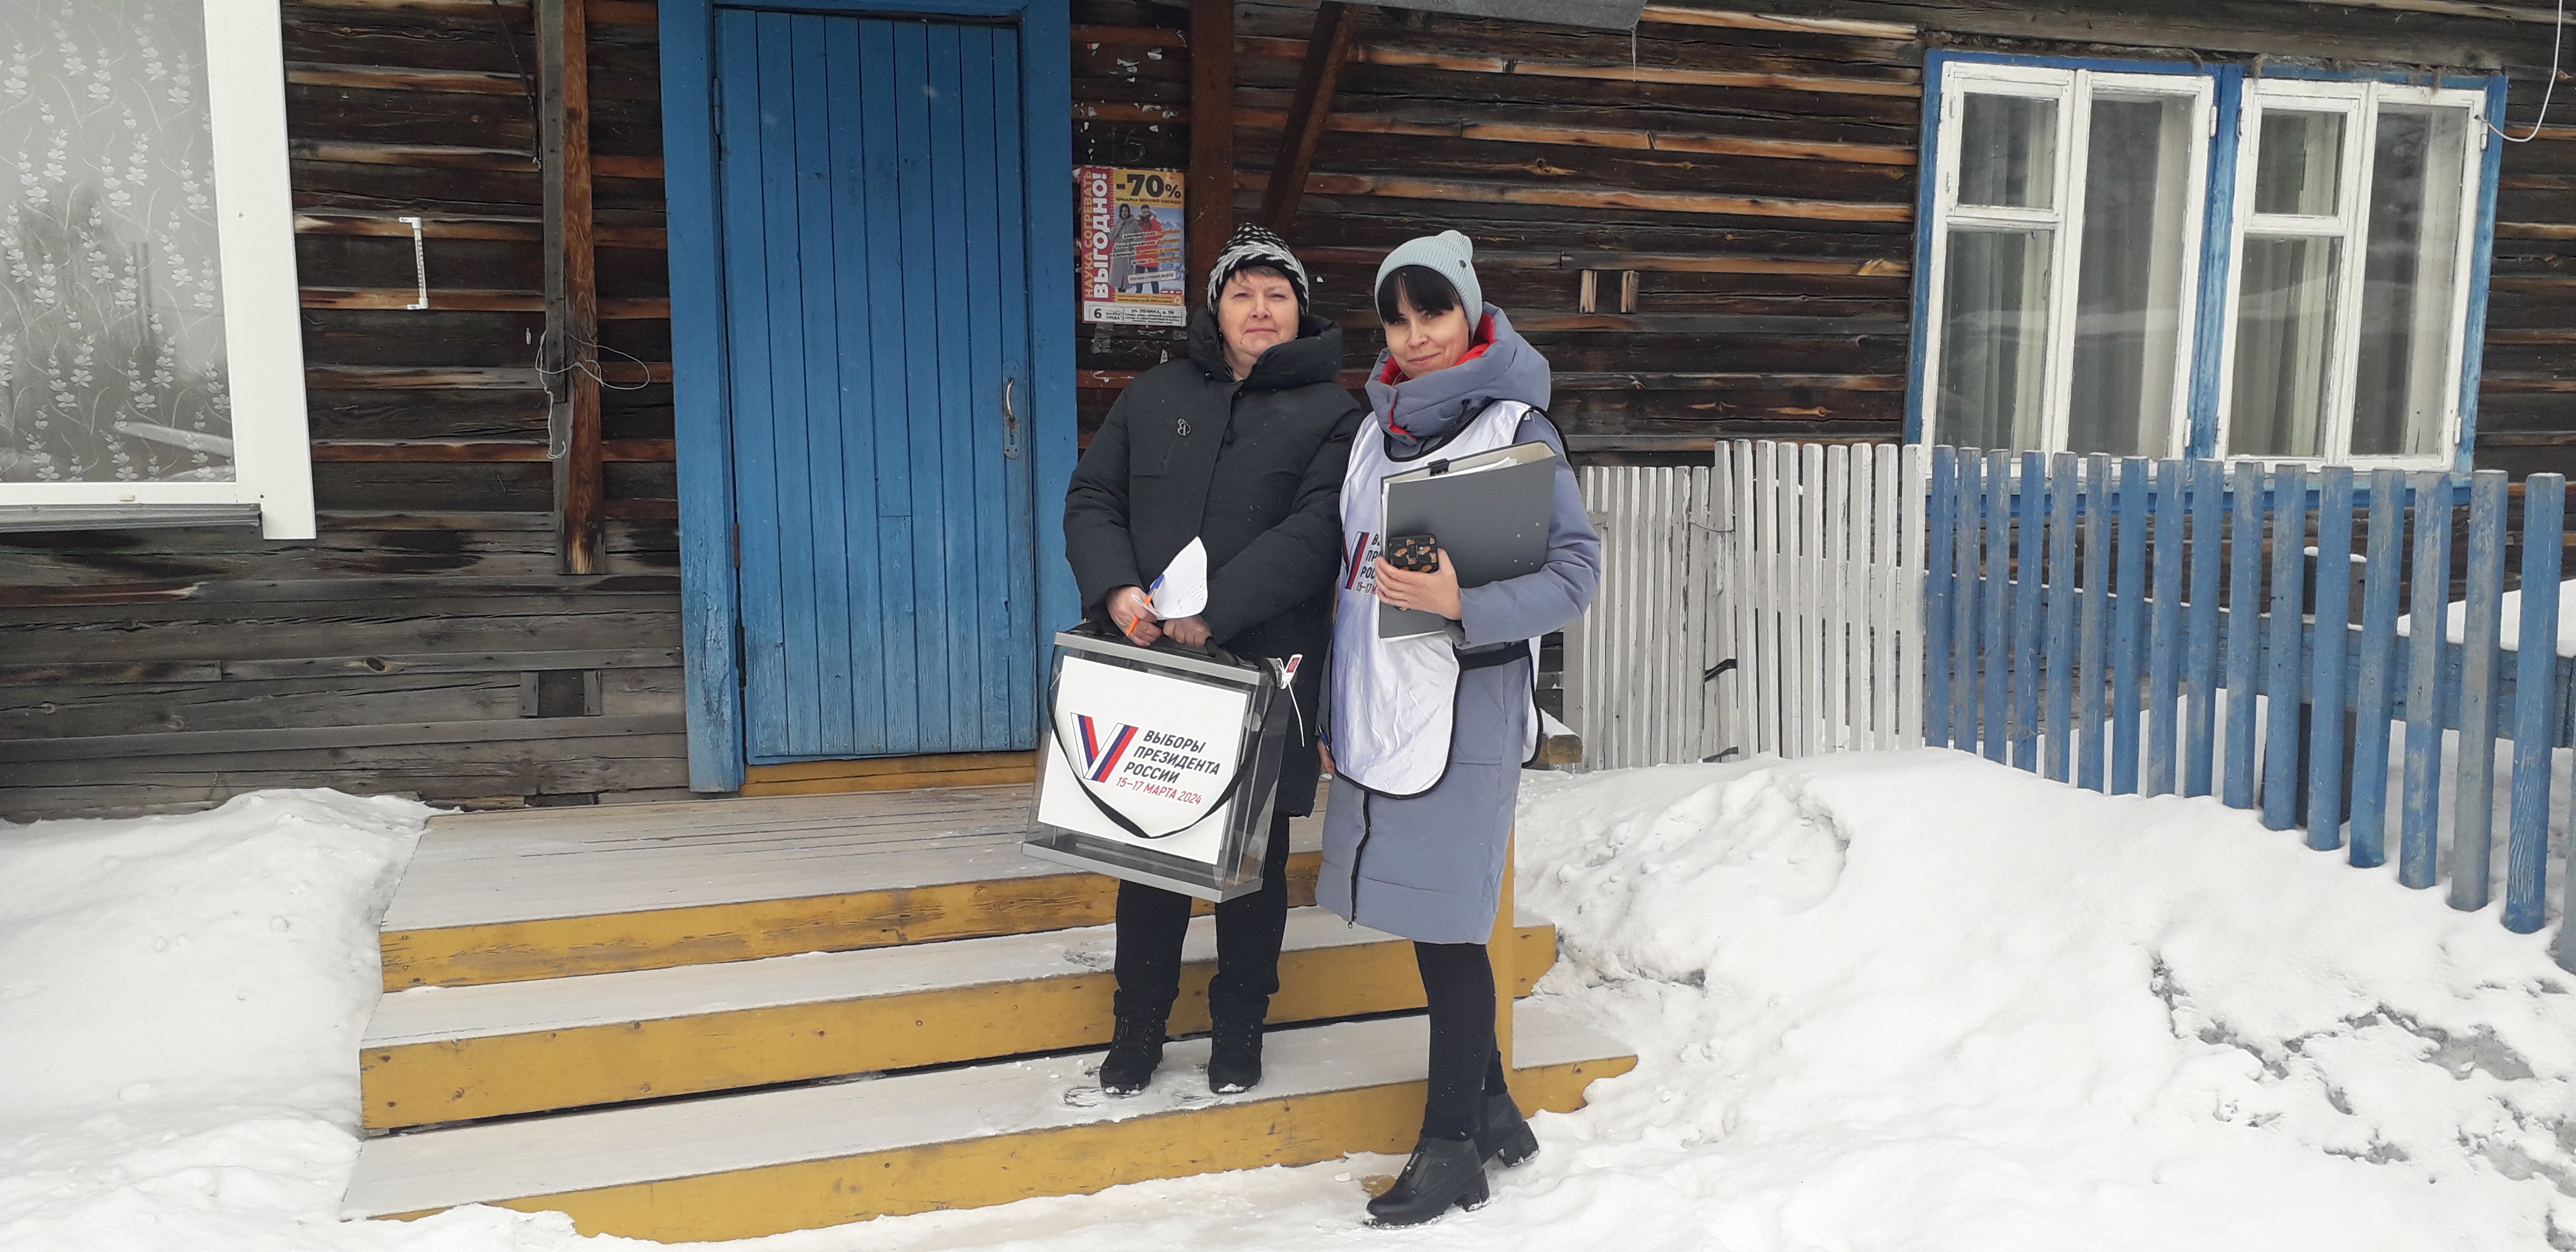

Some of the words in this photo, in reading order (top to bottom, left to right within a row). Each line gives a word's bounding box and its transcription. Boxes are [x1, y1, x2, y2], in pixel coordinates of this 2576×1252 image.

[1116, 174, 1181, 198] -70%
[1083, 170, 1093, 248] СОГРЕВАТЬ
[1092, 172, 1110, 298] ВЫГОДНО!
[1084, 252, 1093, 298] НАУКА
[1094, 308, 1102, 319] 6
[1143, 730, 1207, 754] ВЫБОРЫ
[1123, 761, 1181, 784] РОССИИ
[1133, 745, 1221, 776] ПРЕЗИДЕНТА
[1143, 783, 1178, 800] МАРТА
[1177, 790, 1203, 805] 2024
